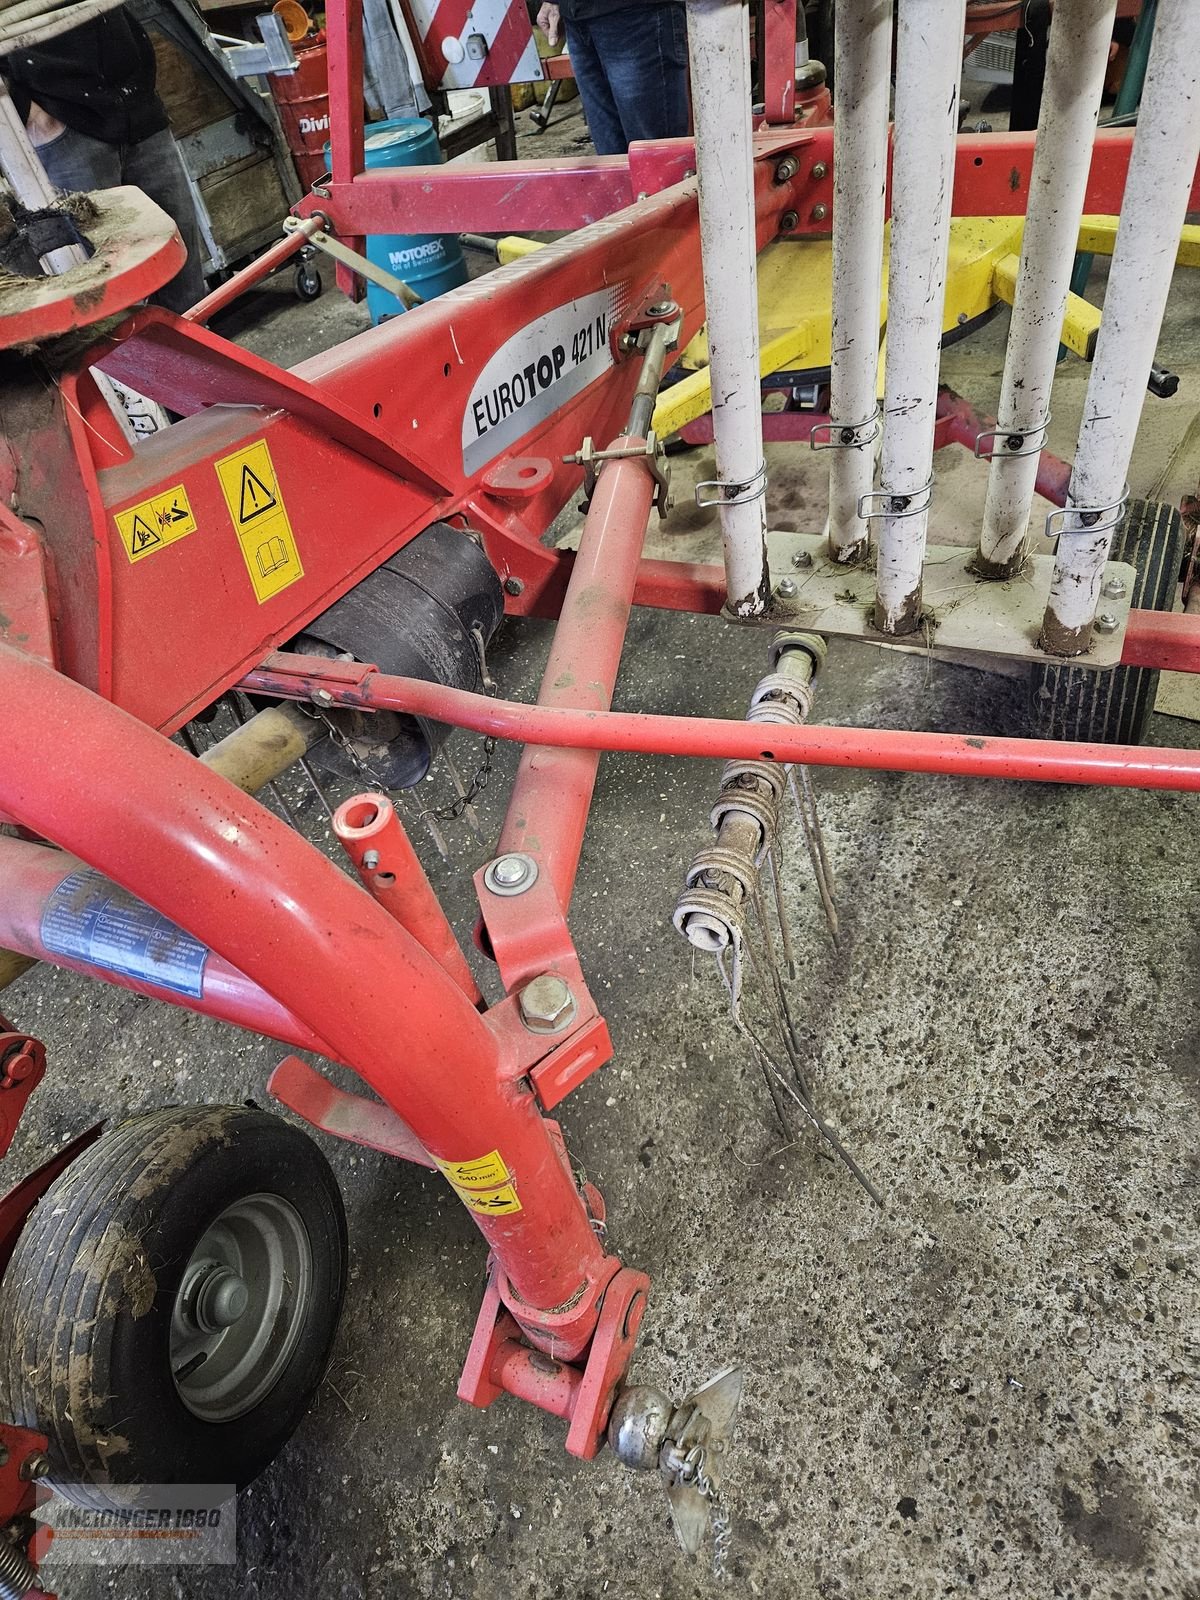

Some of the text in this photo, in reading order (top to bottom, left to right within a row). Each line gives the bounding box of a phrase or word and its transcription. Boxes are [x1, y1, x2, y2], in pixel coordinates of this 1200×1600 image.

[299, 114, 331, 133] Divi
[388, 238, 444, 265] MOTOREX
[472, 313, 606, 437] EUROTOP 421 N
